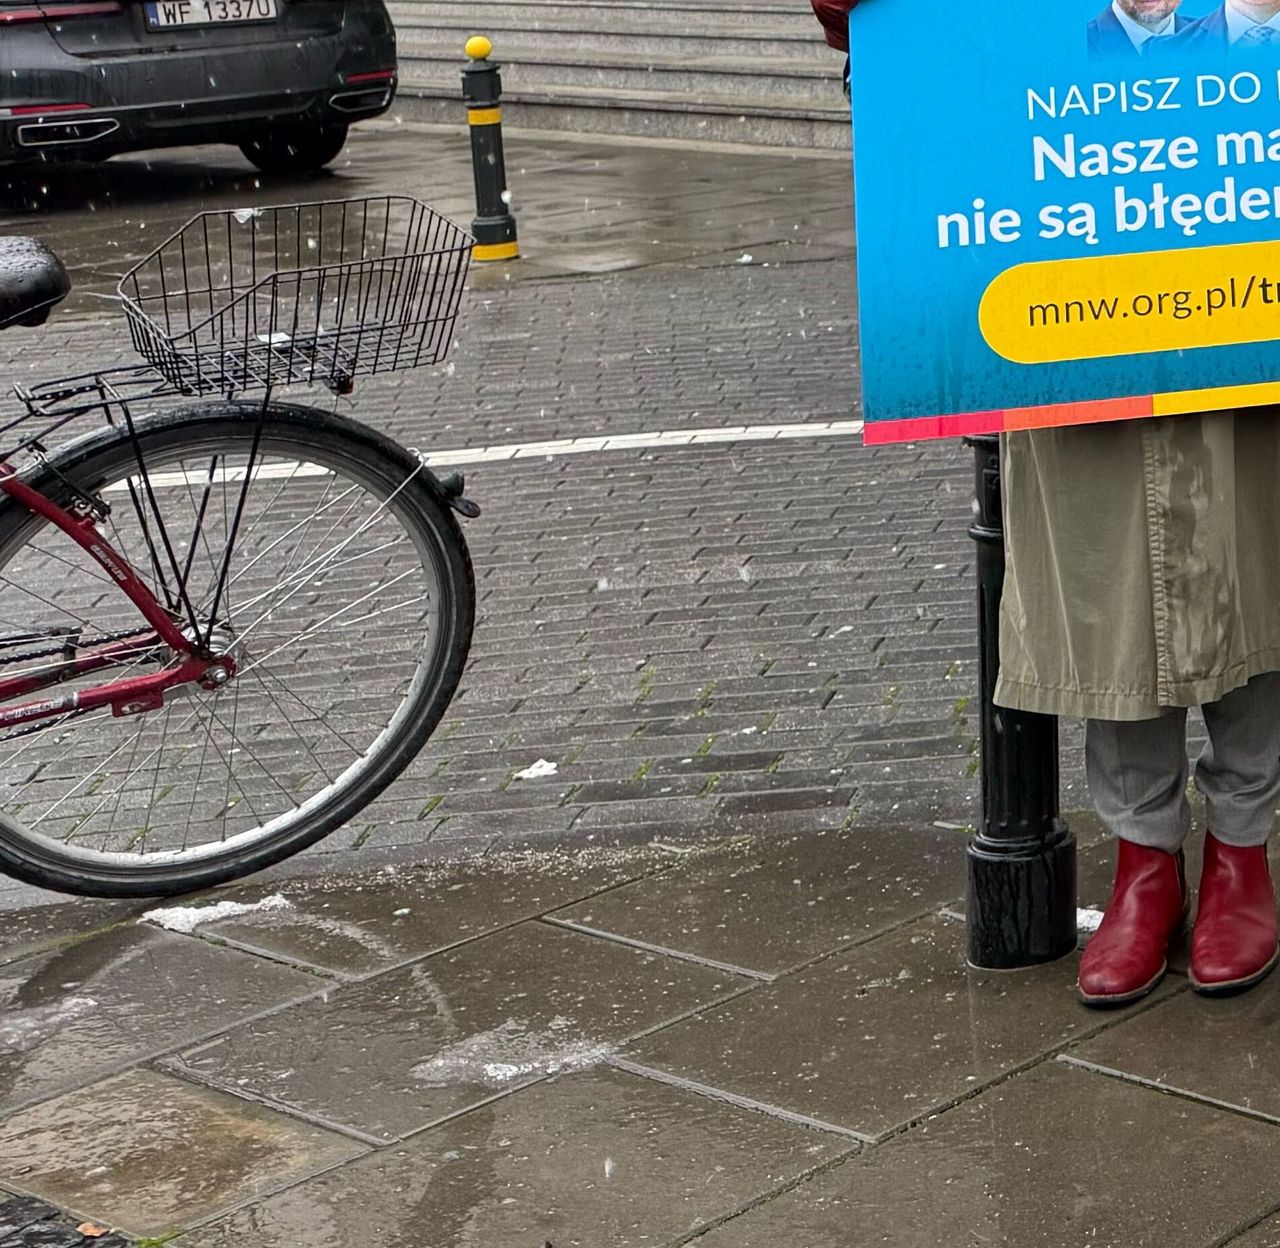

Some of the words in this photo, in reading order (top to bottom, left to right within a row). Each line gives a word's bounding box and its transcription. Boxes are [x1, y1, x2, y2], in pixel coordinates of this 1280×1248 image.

[163, 2, 190, 24] WF
[1027, 77, 1181, 120] NAPISZ
[1197, 72, 1261, 107] DO
[1033, 133, 1199, 181] Nasze
[937, 197, 1022, 248] nie
[1038, 202, 1100, 245] są
